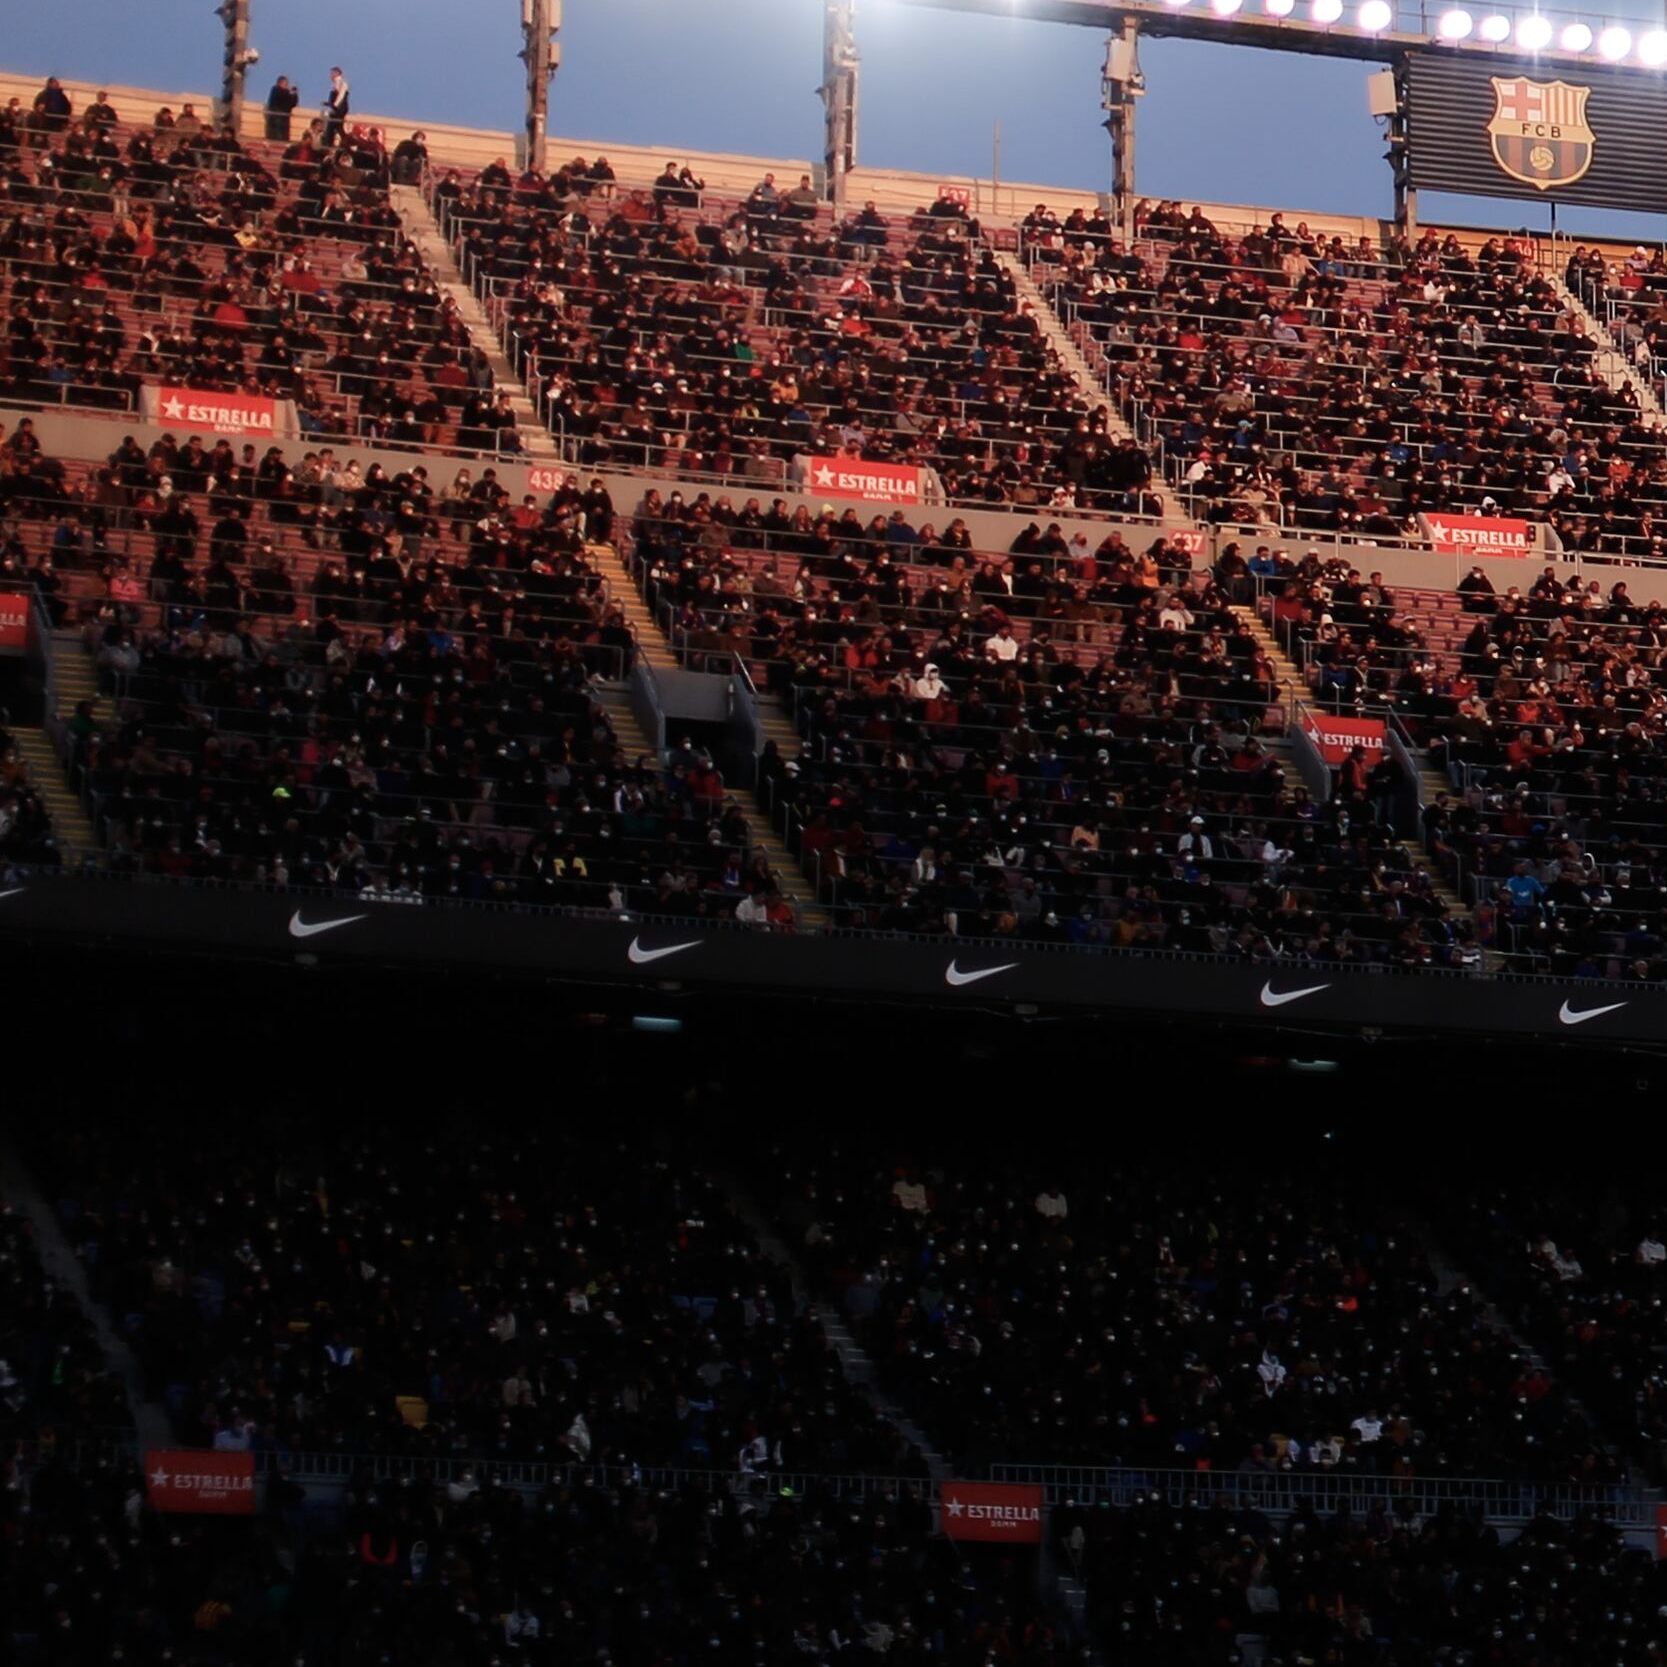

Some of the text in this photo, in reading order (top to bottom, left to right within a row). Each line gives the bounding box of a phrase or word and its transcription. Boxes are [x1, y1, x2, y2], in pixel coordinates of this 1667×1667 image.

[188, 405, 272, 428] ESTRELLA
[838, 472, 917, 495] ESTRELLA
[1451, 528, 1526, 548] ESTRELLA
[173, 1474, 253, 1491] ESTRELLA
[967, 1504, 1040, 1521] ESTRELLA
